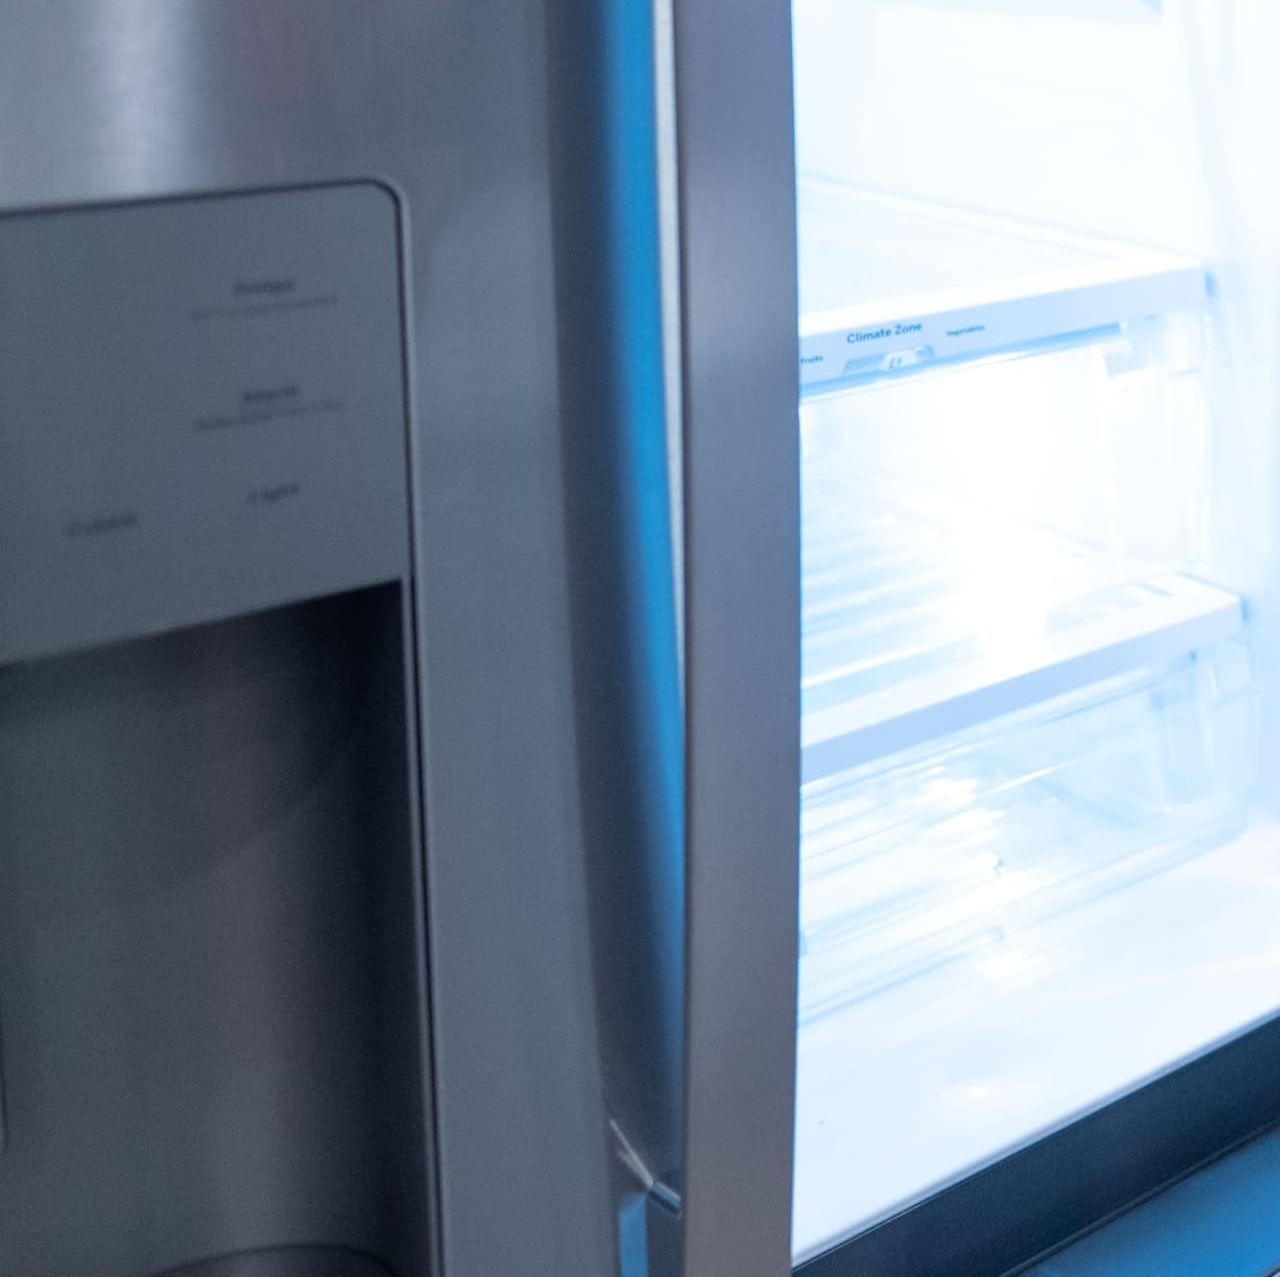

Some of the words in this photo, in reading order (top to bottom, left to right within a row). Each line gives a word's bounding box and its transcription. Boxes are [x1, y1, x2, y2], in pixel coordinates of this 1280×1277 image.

[846, 328, 891, 345] Climate
[894, 322, 923, 336] Zone
[799, 354, 824, 365] Fruits
